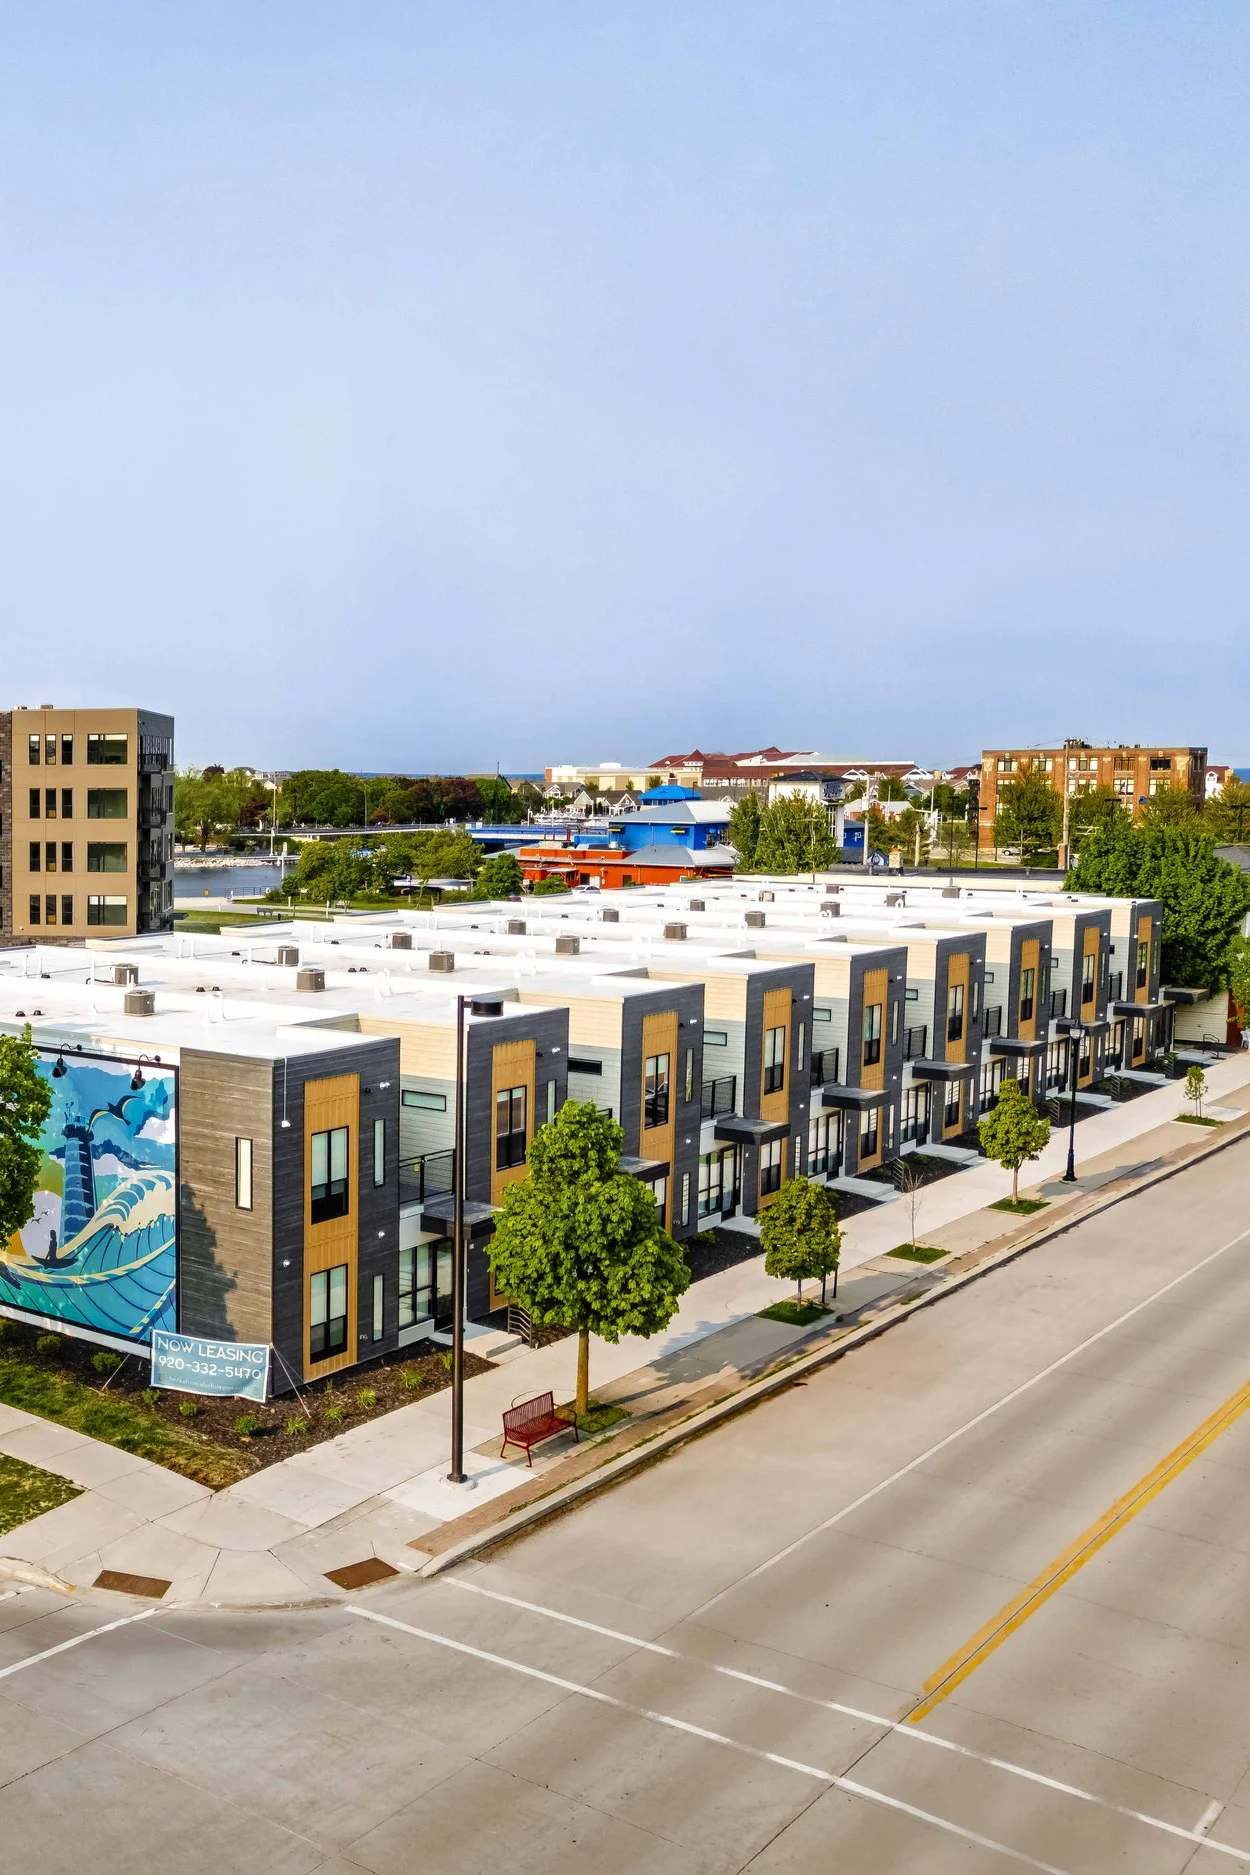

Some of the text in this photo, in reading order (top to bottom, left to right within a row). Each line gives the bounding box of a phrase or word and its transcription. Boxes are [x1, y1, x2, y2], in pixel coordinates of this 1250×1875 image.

[157, 1337, 264, 1364] NOW LEASING
[158, 1355, 262, 1380] 920-332-5470
